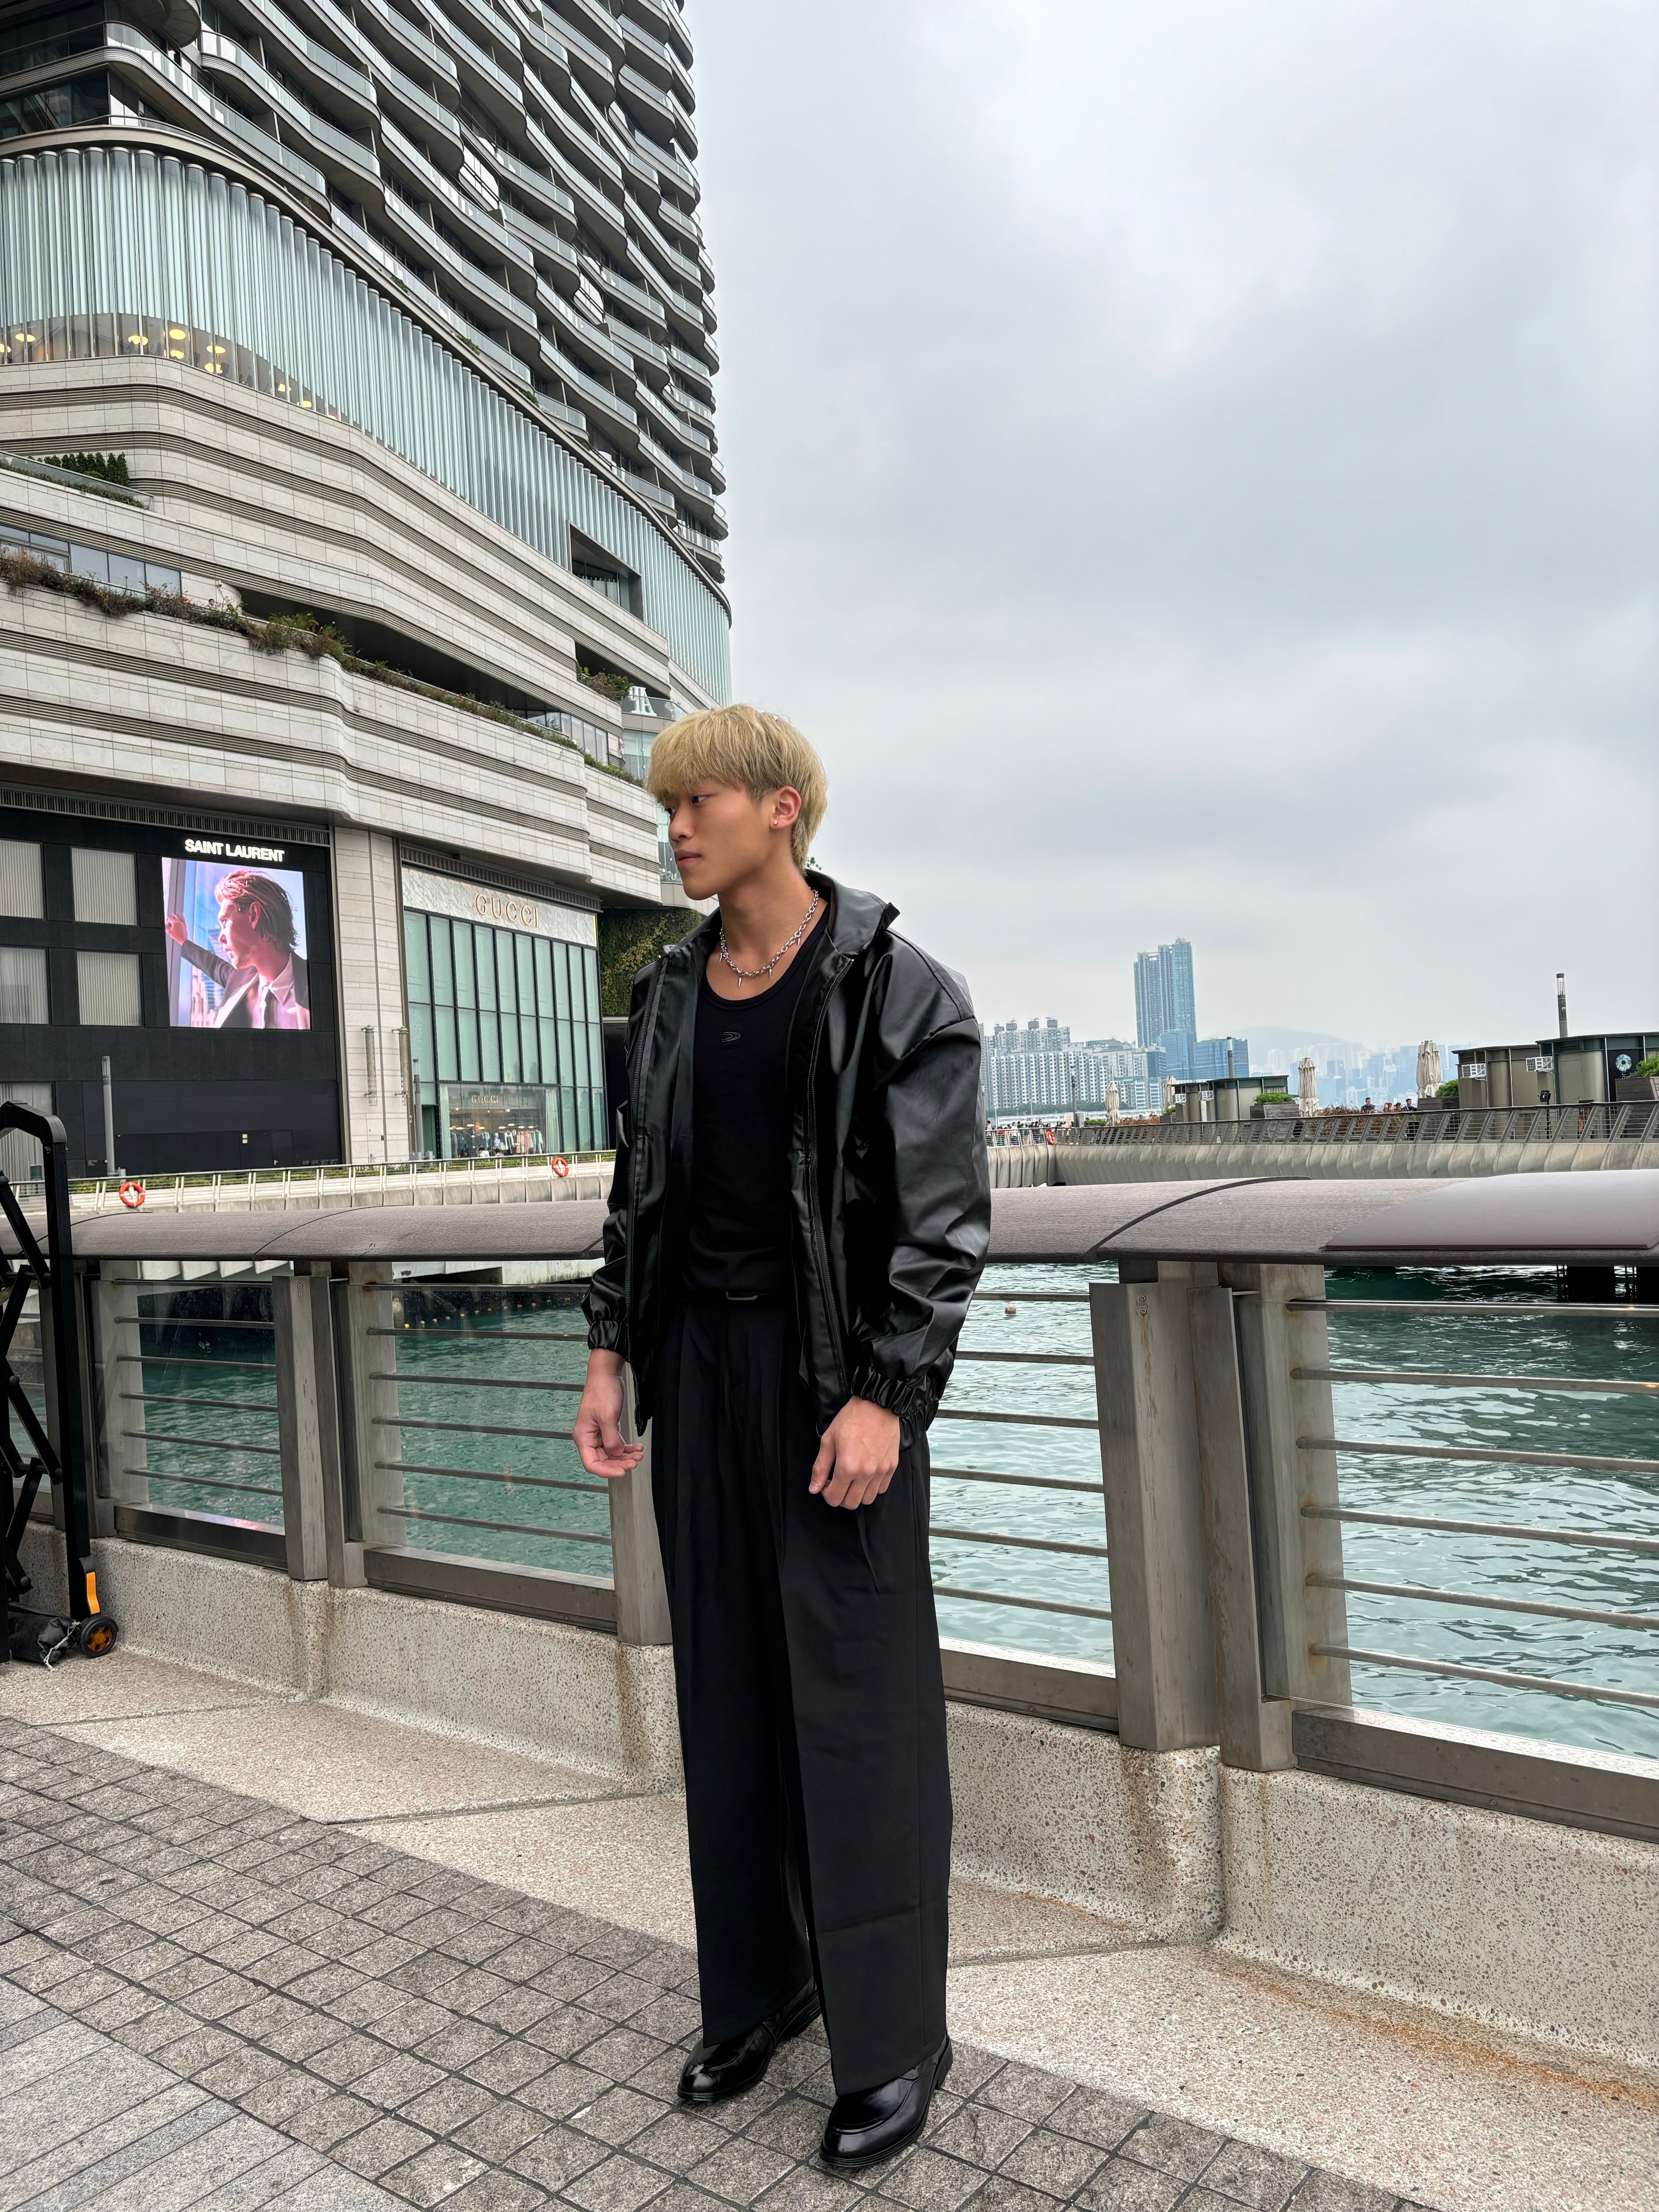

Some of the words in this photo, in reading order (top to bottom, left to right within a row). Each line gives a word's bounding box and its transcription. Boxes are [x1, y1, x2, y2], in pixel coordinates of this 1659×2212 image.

[185, 839, 224, 855] SAINT
[226, 843, 285, 862] LAURENT
[474, 893, 538, 927] GUCCI
[471, 1094, 499, 1104] GUCCI
